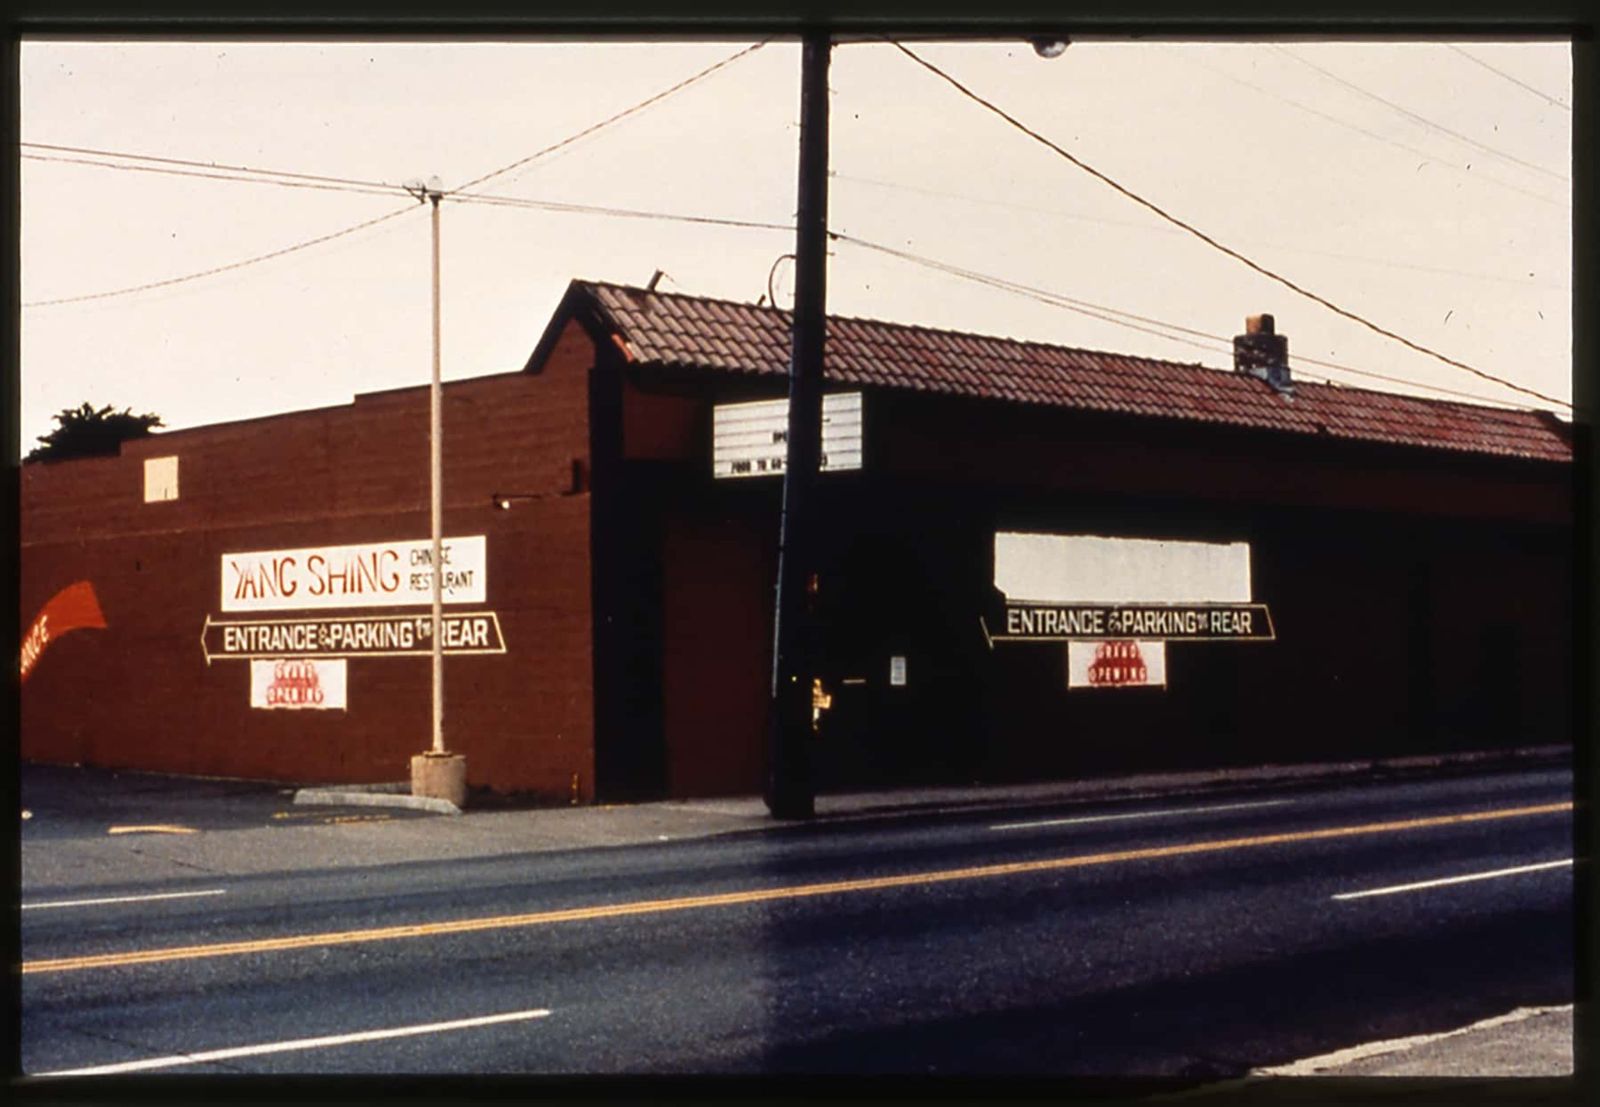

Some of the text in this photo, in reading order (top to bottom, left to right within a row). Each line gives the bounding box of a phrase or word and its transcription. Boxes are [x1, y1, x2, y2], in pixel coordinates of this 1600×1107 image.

[230, 549, 399, 600] YANG SHING
[1007, 609, 1104, 634] ENTRANCE
[1121, 610, 1196, 634] PARKING
[1210, 611, 1252, 634] REAR
[224, 624, 318, 652] ENTRANCE
[330, 620, 413, 649] PARKING
[1088, 666, 1147, 684] OPENING
